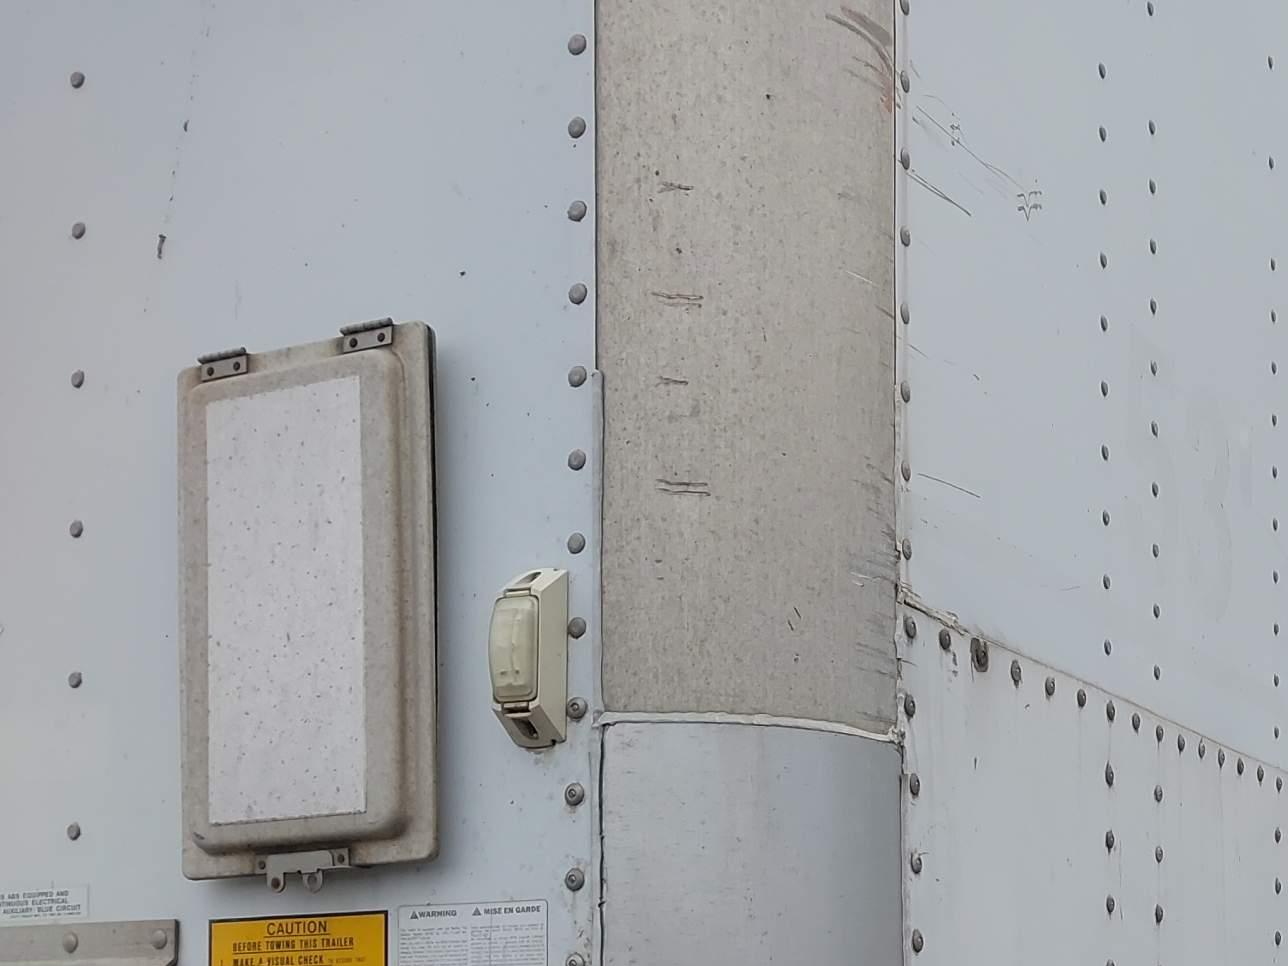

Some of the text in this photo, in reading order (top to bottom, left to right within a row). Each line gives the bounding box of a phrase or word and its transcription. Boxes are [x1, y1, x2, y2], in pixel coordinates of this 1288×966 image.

[418, 910, 457, 918] WARNING
[516, 906, 541, 914] GARDE
[266, 920, 328, 936] CAUTION
[232, 936, 354, 952] BEFORE TOWING THIS TRAILER
[267, 956, 294, 966] VISUAL
[298, 955, 324, 965] CHECK
